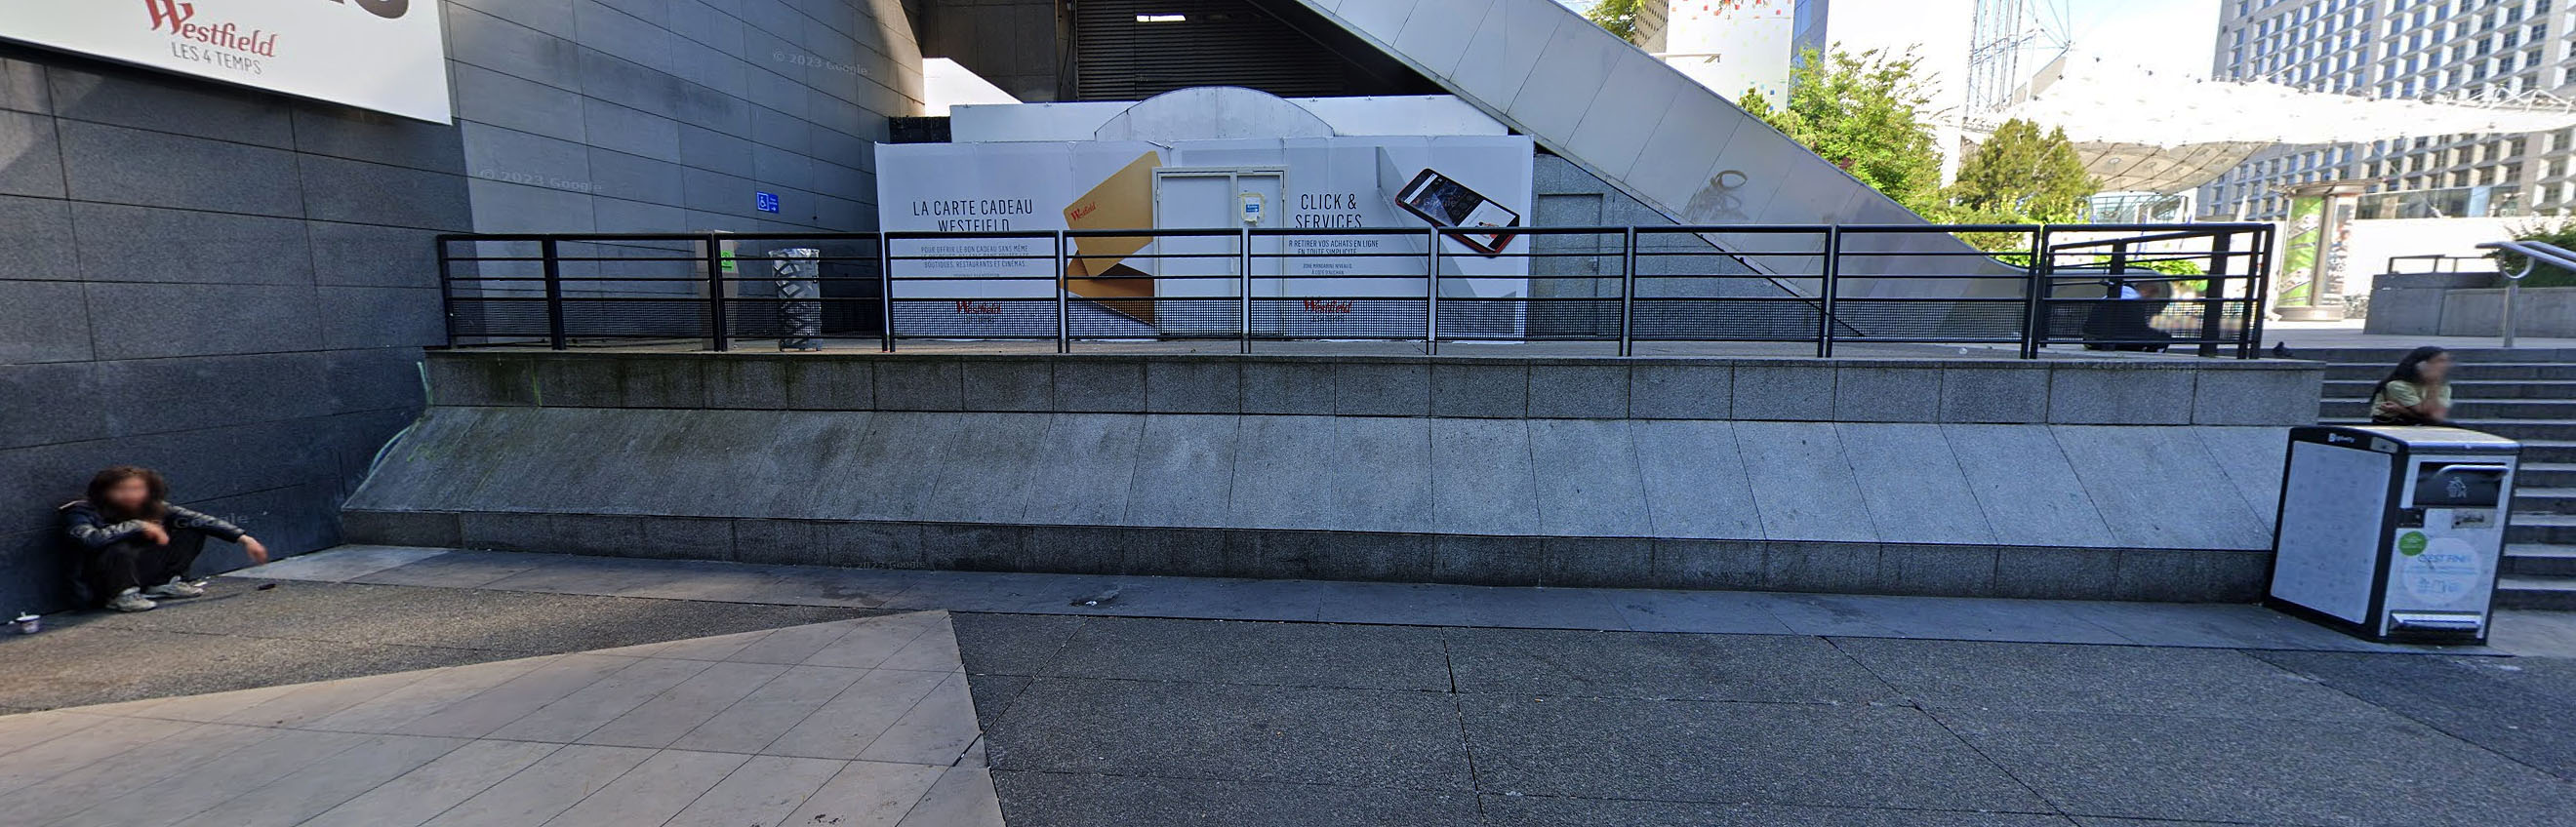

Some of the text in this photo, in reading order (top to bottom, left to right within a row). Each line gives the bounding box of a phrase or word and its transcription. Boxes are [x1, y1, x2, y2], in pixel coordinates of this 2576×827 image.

[145, 0, 279, 58] Westfield
[171, 42, 262, 75] LES 4 TEMPS
[912, 199, 1032, 217] LA CARTE CADEAU
[1301, 193, 1357, 210] CLICK &
[938, 218, 1010, 232] WESTFIELD
[1295, 214, 1362, 228] SERVICES
[1294, 239, 1317, 248] RETIRER
[1318, 239, 1330, 248] VOS
[1330, 239, 1353, 248] ACHATS
[1353, 239, 1361, 248] EN
[1362, 239, 1379, 248] LIGNE
